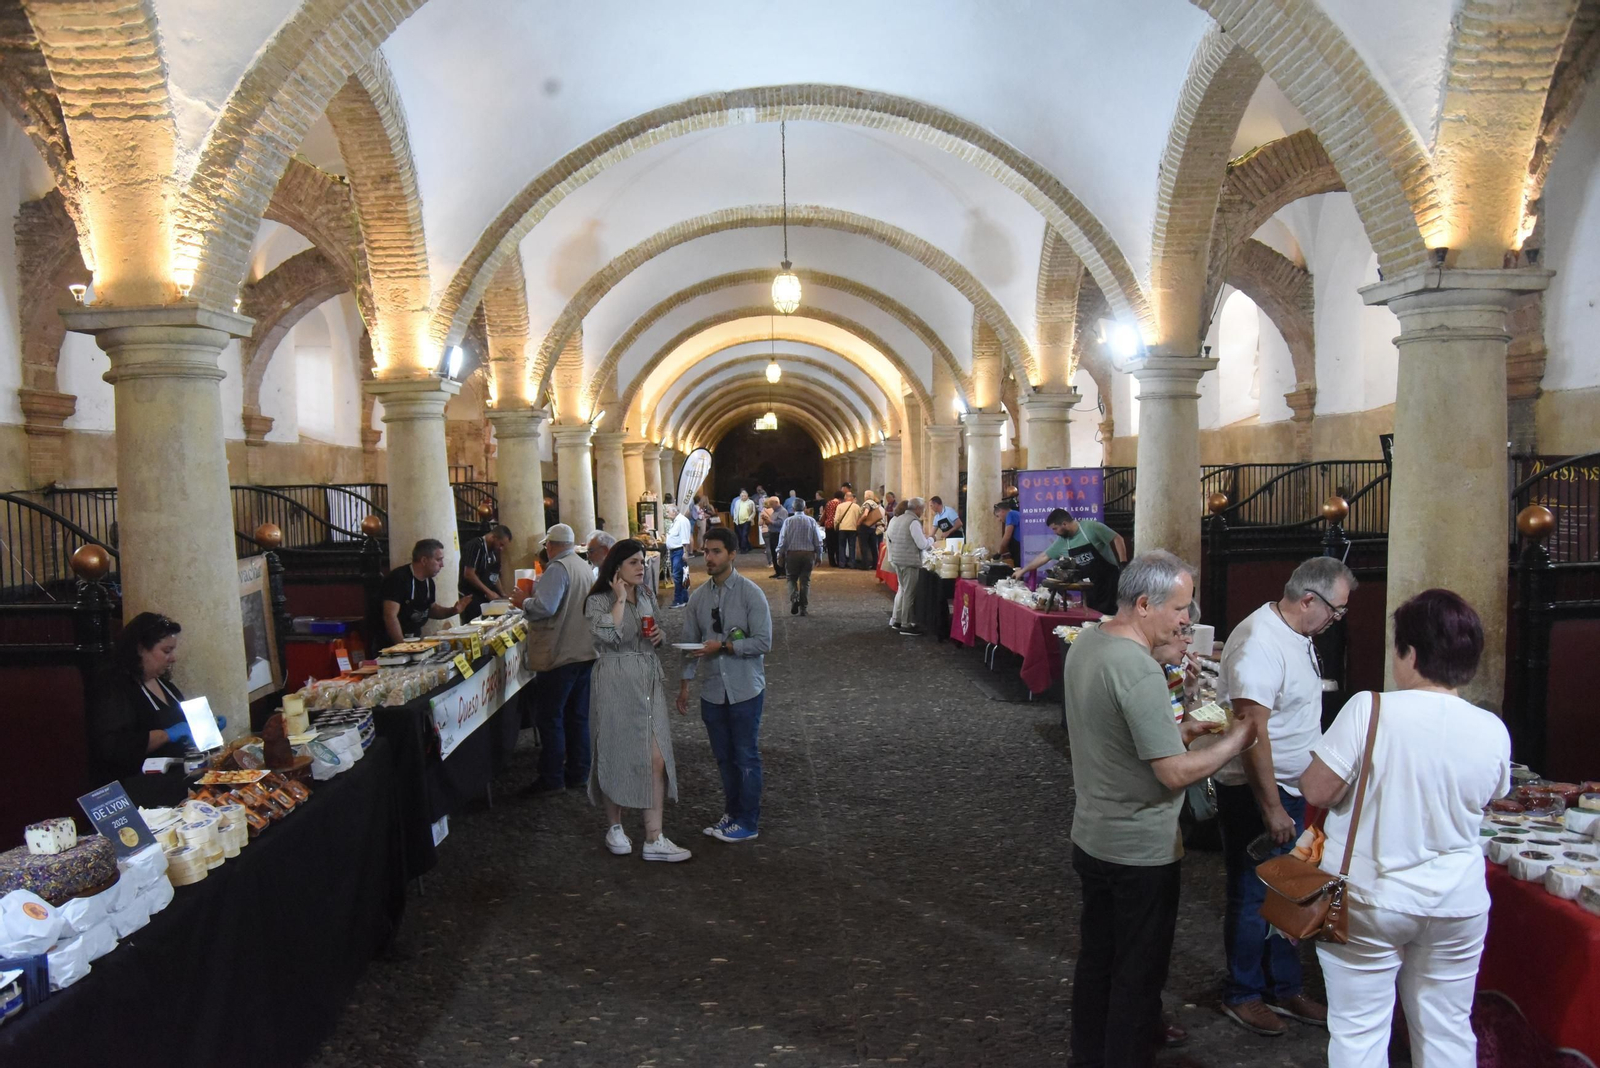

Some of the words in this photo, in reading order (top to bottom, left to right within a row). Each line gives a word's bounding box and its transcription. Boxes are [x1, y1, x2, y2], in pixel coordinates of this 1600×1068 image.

[1022, 476, 1072, 489] QUESO
[1080, 475, 1099, 485] DE
[1035, 490, 1086, 501] CABRA
[92, 808, 107, 821] DE
[105, 797, 130, 815] LYON
[111, 815, 128, 829] 2025
